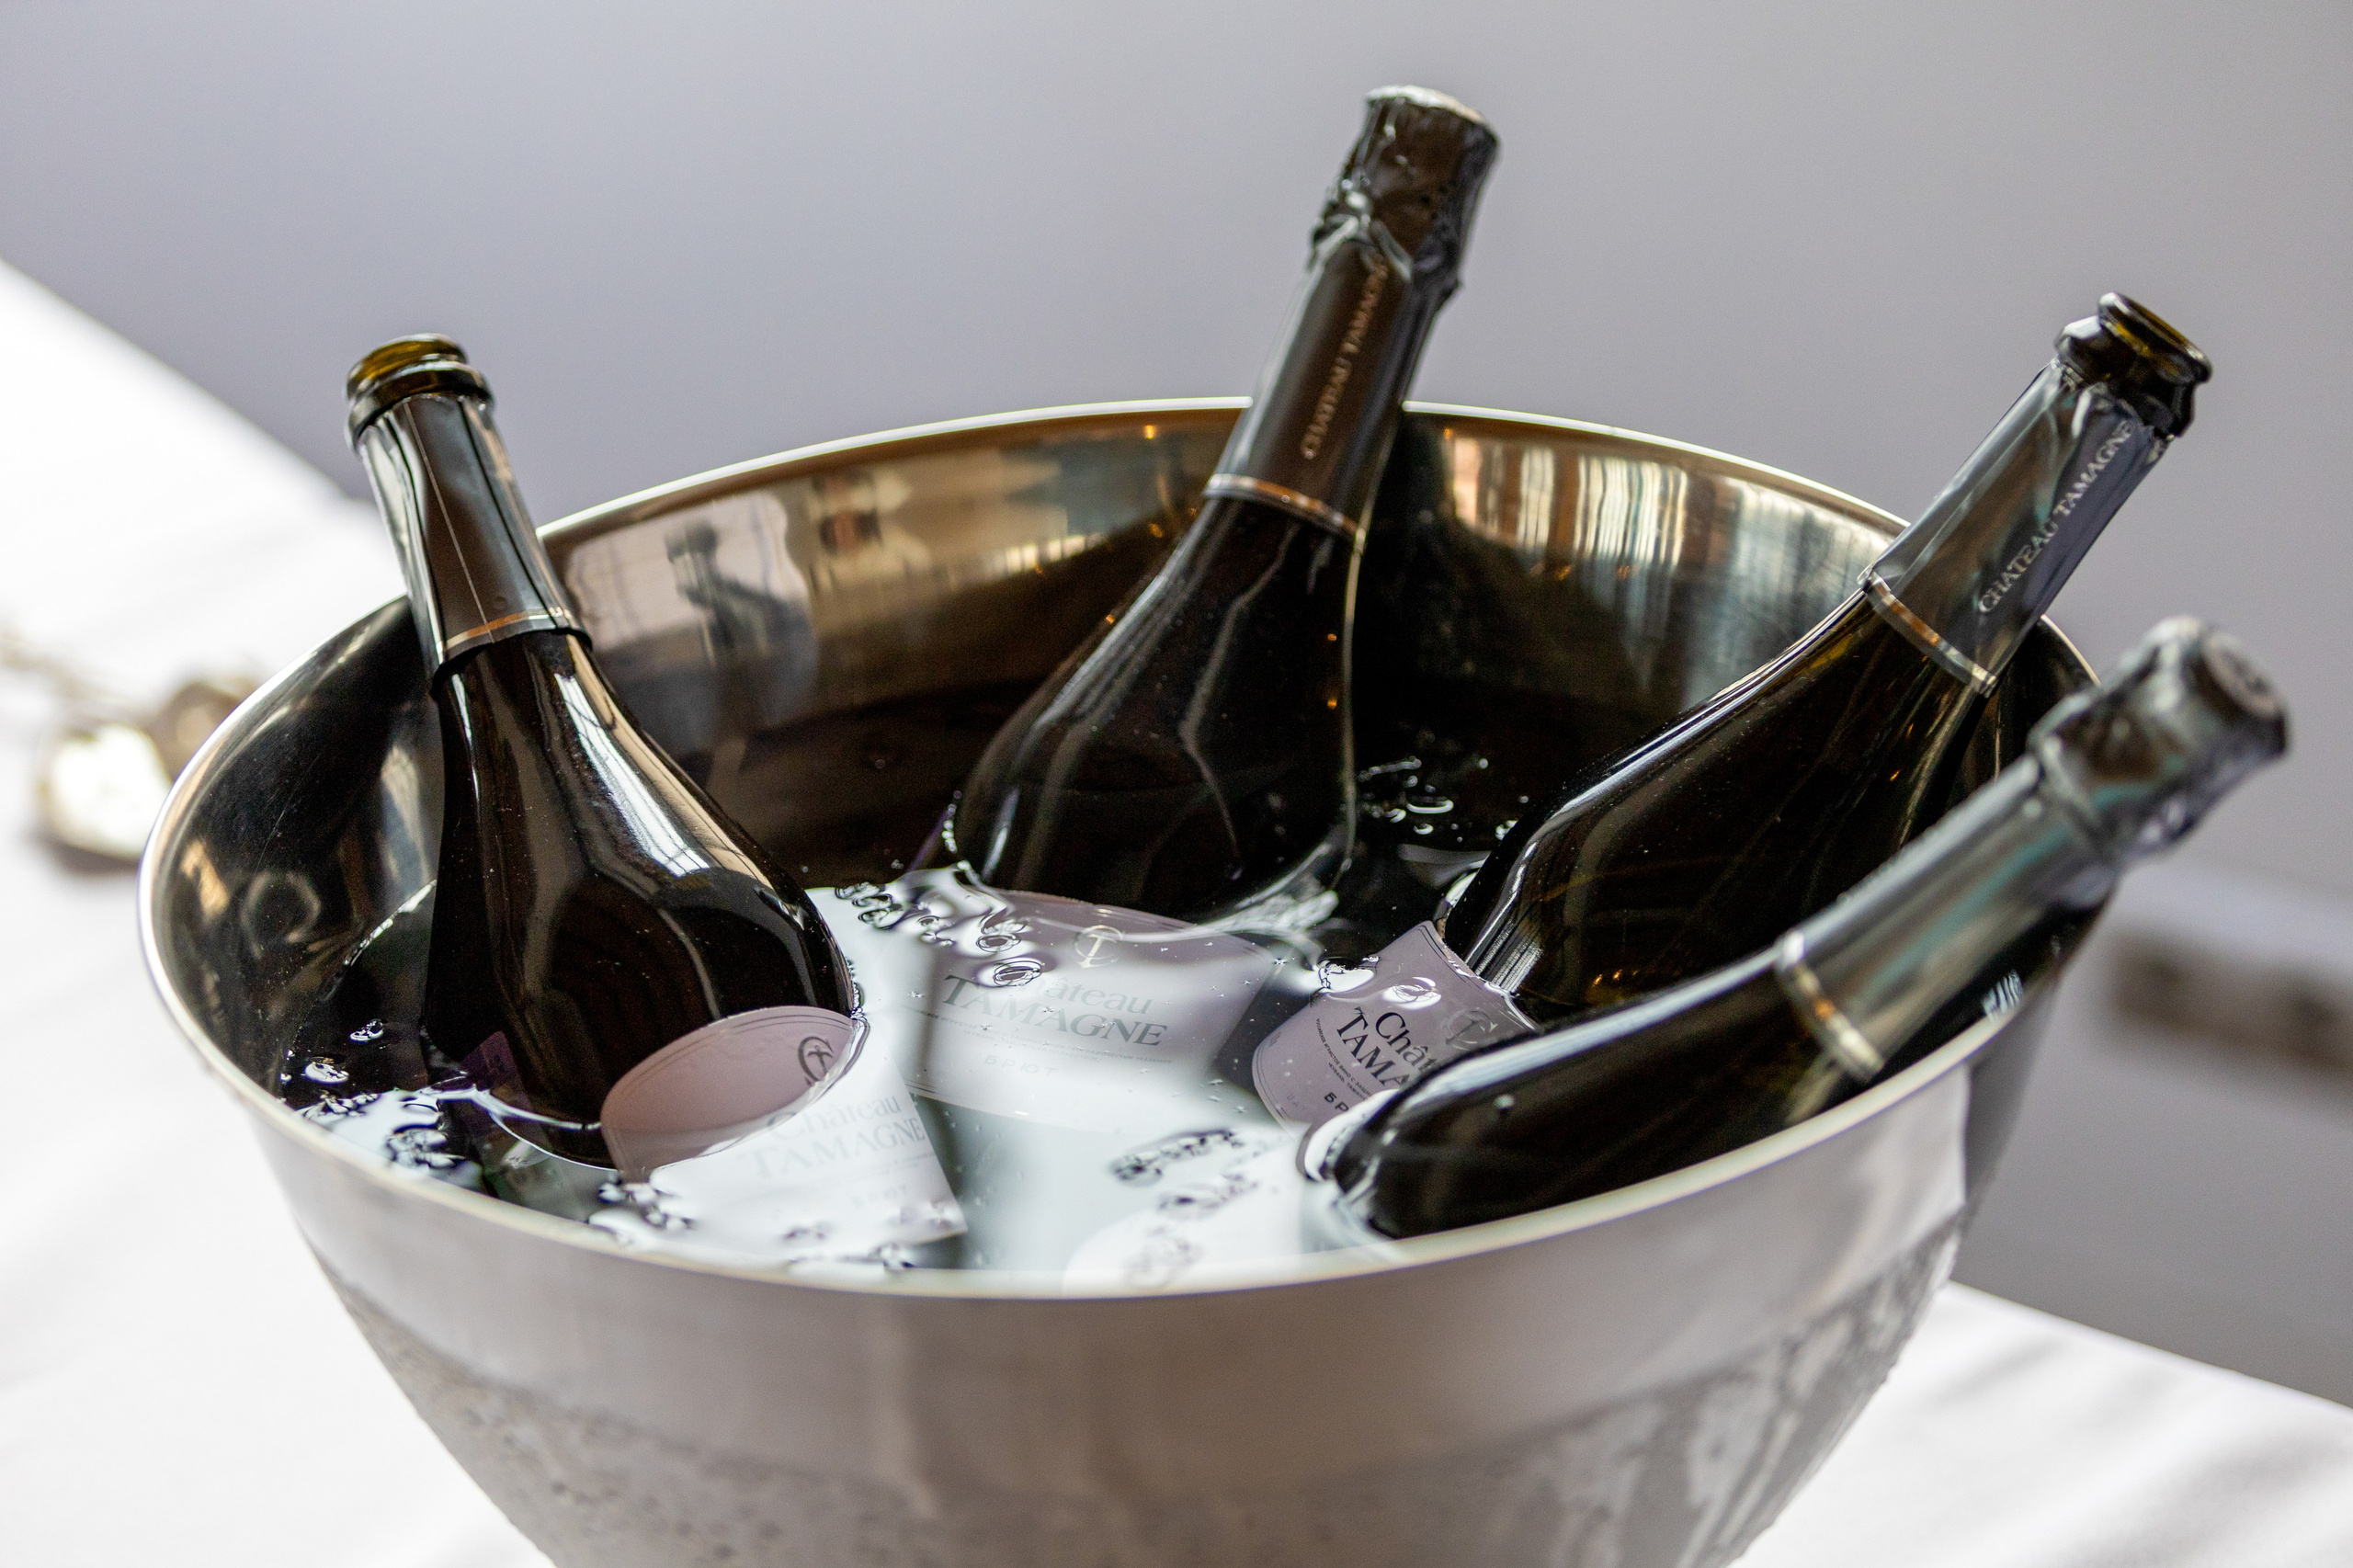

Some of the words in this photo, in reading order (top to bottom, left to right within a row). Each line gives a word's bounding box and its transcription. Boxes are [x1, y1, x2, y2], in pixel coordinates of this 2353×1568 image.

[1978, 519, 2059, 613] CHATEAU
[944, 974, 1168, 1047] TAMAGNE
[983, 1054, 1059, 1077] БРЮТ
[734, 1117, 926, 1179] TAMAGNE
